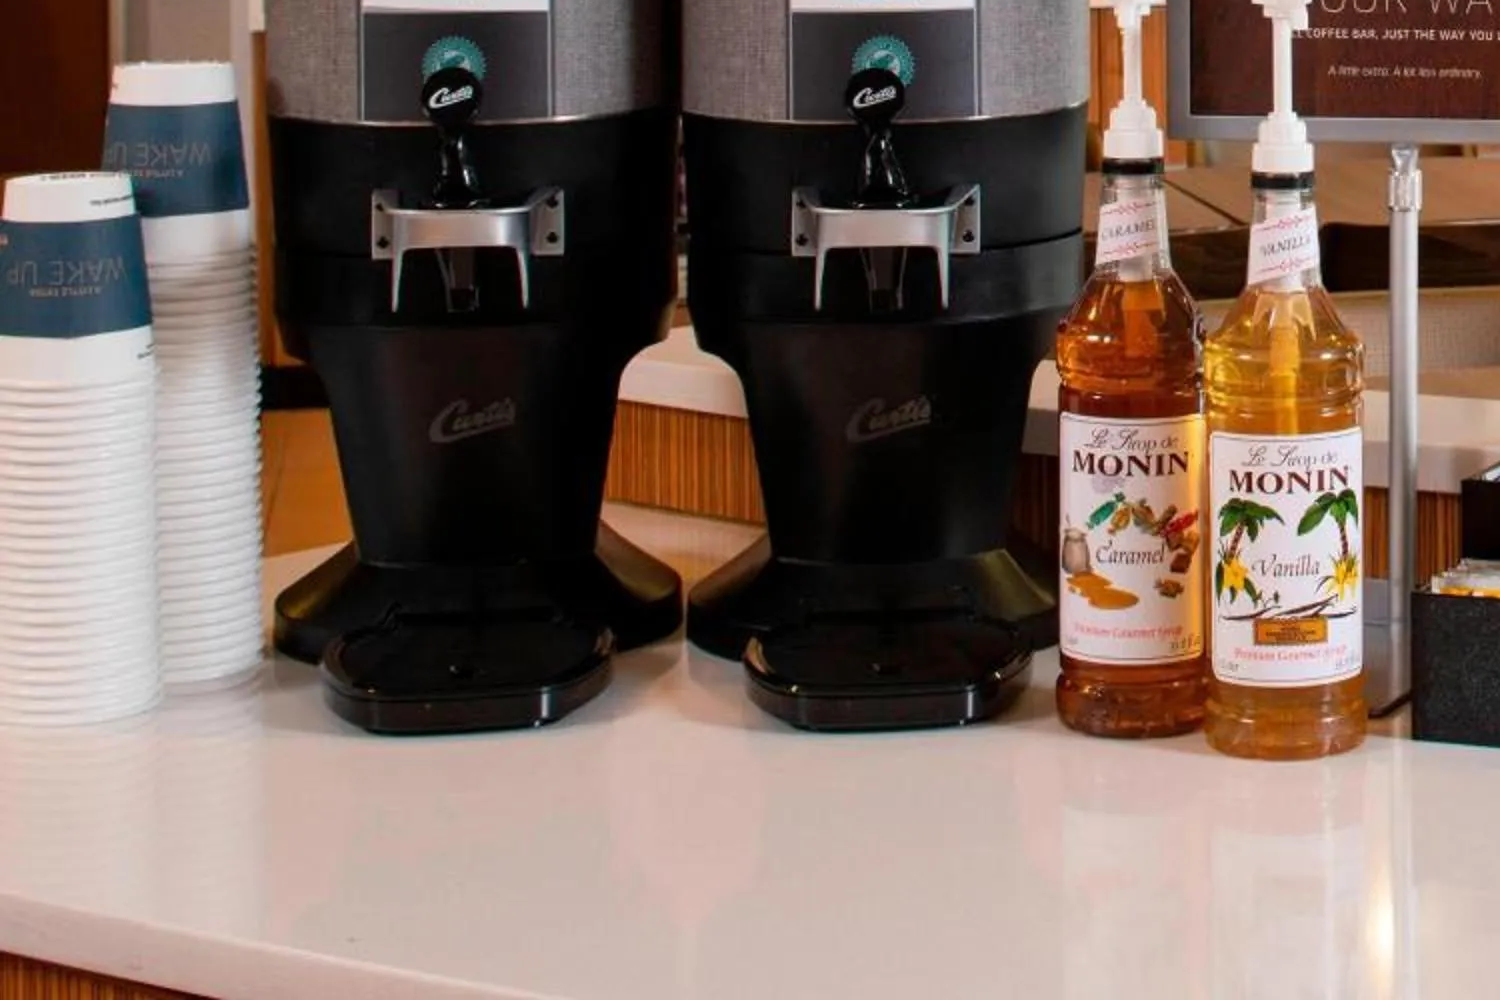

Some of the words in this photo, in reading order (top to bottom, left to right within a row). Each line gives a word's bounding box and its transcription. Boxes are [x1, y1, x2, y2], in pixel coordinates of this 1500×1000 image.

[1308, 27, 1349, 39] COFFEE
[1352, 28, 1378, 41] BAR,
[1382, 28, 1410, 40] JUST
[1413, 29, 1435, 41] THE
[1437, 29, 1466, 41] WAY
[1469, 30, 1493, 41] YOU
[132, 141, 211, 168] WAKE
[6, 260, 38, 288] UP
[48, 256, 128, 286] WAKE
[1072, 450, 1189, 477] MONIN
[1229, 465, 1349, 494] MONIN
[1096, 539, 1165, 566] Caramel
[1252, 553, 1321, 578] Vanilla
